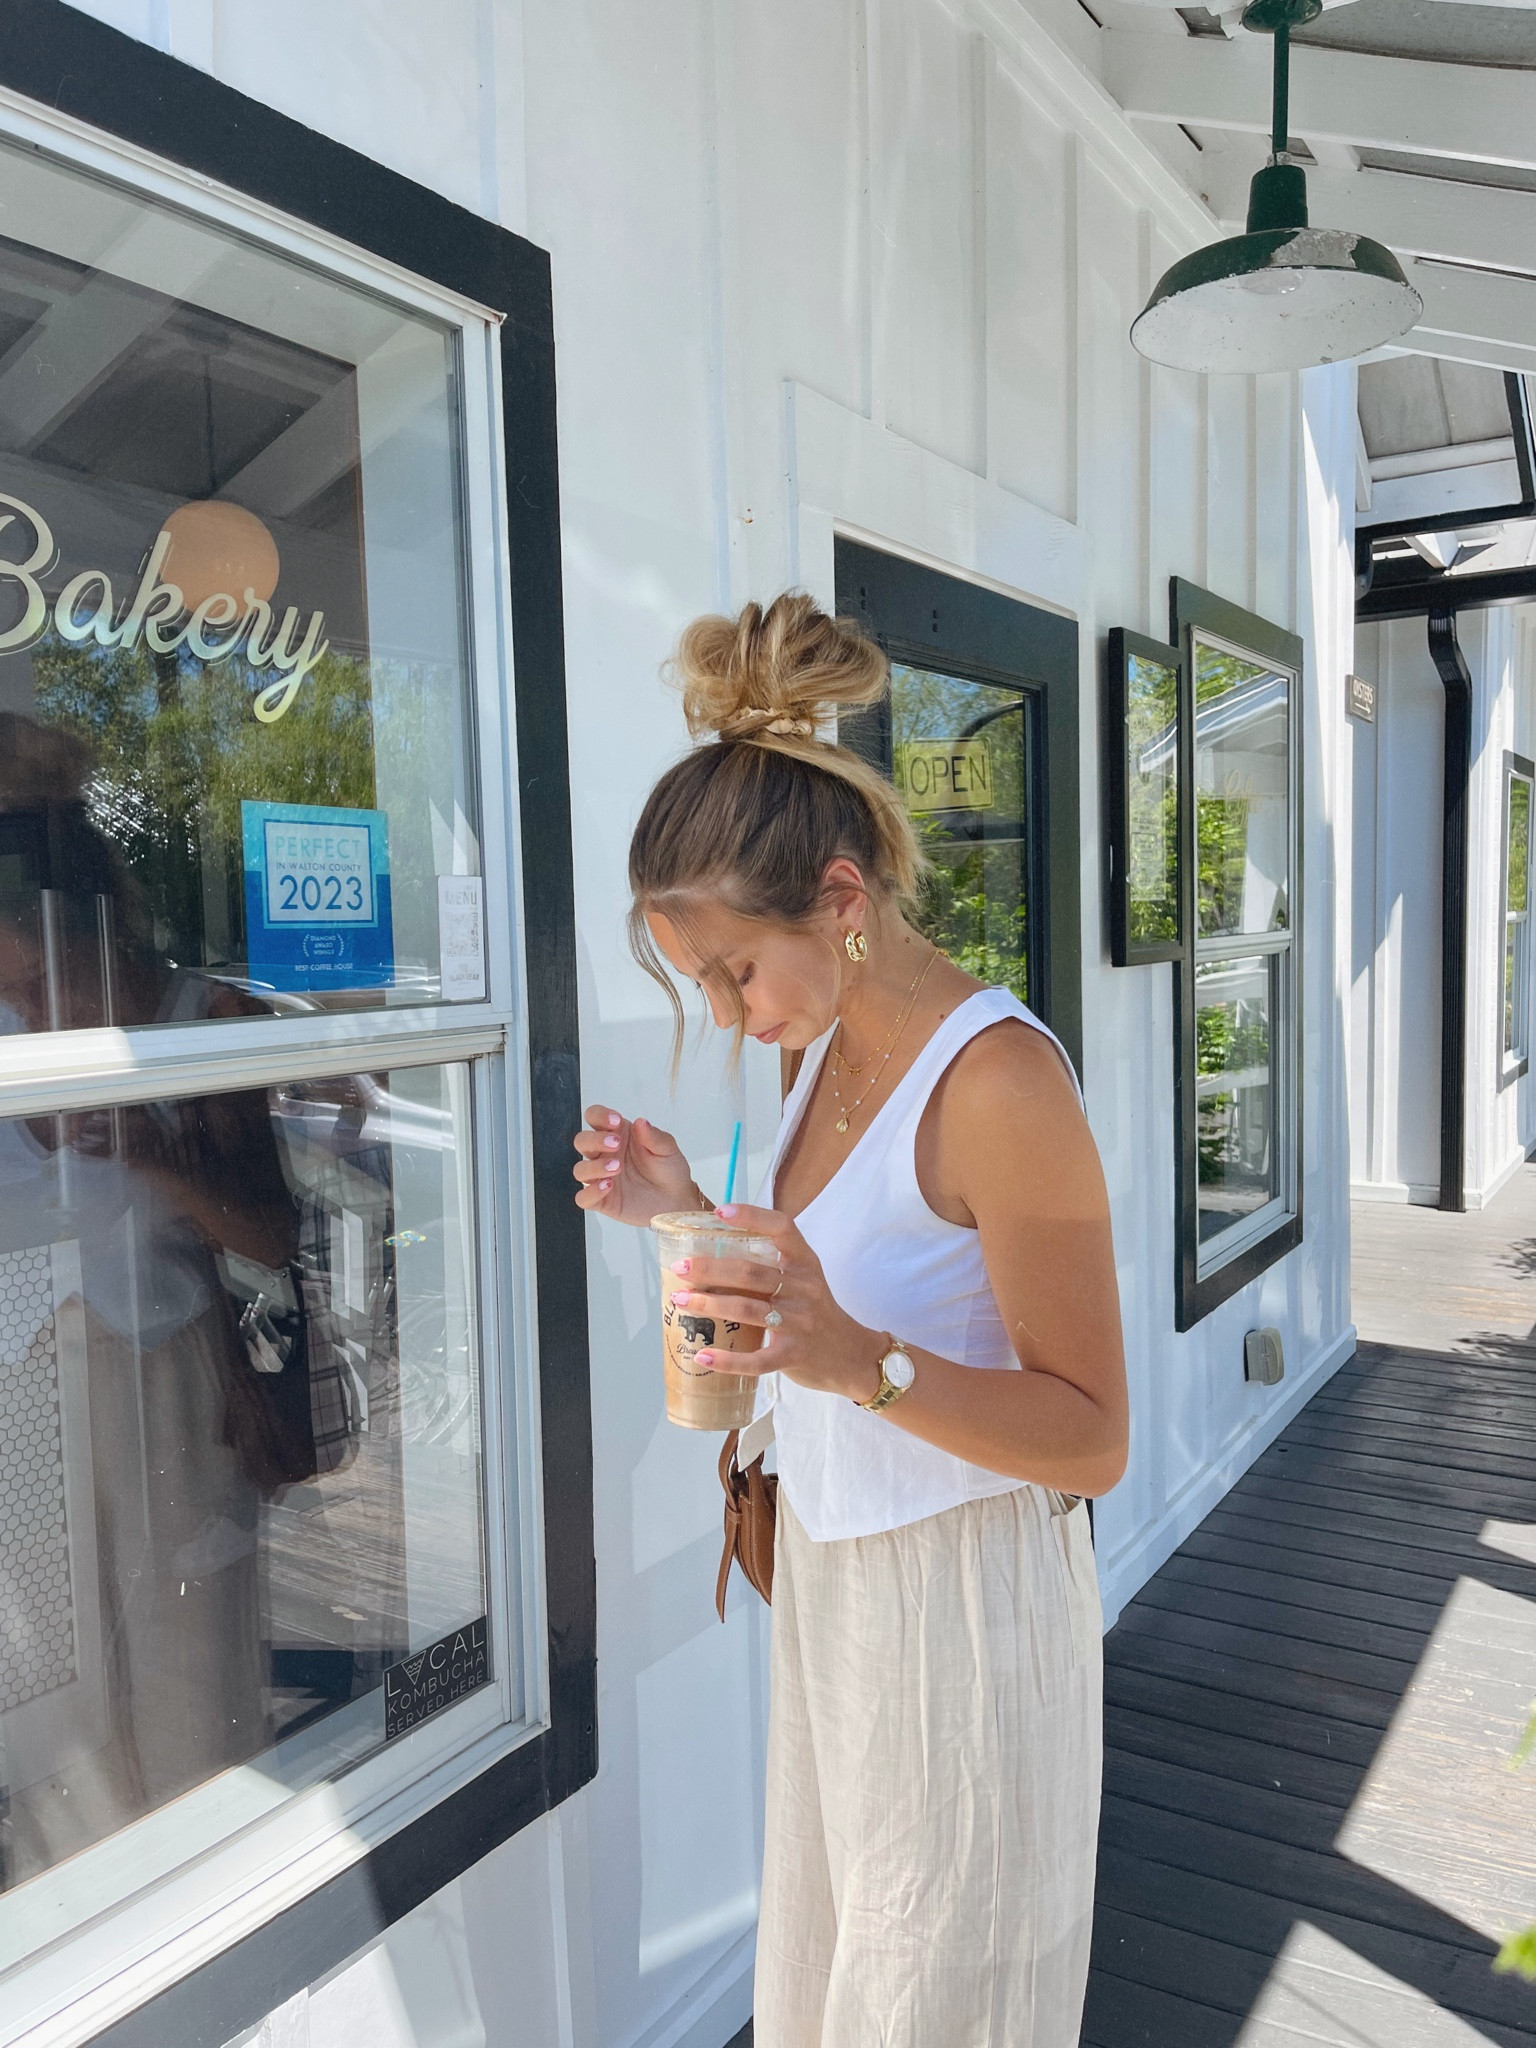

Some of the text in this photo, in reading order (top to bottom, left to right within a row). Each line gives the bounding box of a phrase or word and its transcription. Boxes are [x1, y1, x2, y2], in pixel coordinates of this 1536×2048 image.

[0, 492, 329, 723] Bakery
[910, 754, 986, 796] OPEN
[275, 836, 361, 858] PERFECT
[276, 862, 362, 872] IN WALTON COUNTY
[279, 874, 363, 911] 2023
[445, 889, 478, 905] MENU
[295, 962, 353, 972] BEST COFFEE HOUSE
[676, 1343, 699, 1355] Brea
[388, 1650, 485, 1718] KOMBUCHA
[387, 1670, 483, 1738] SERVED HERE
